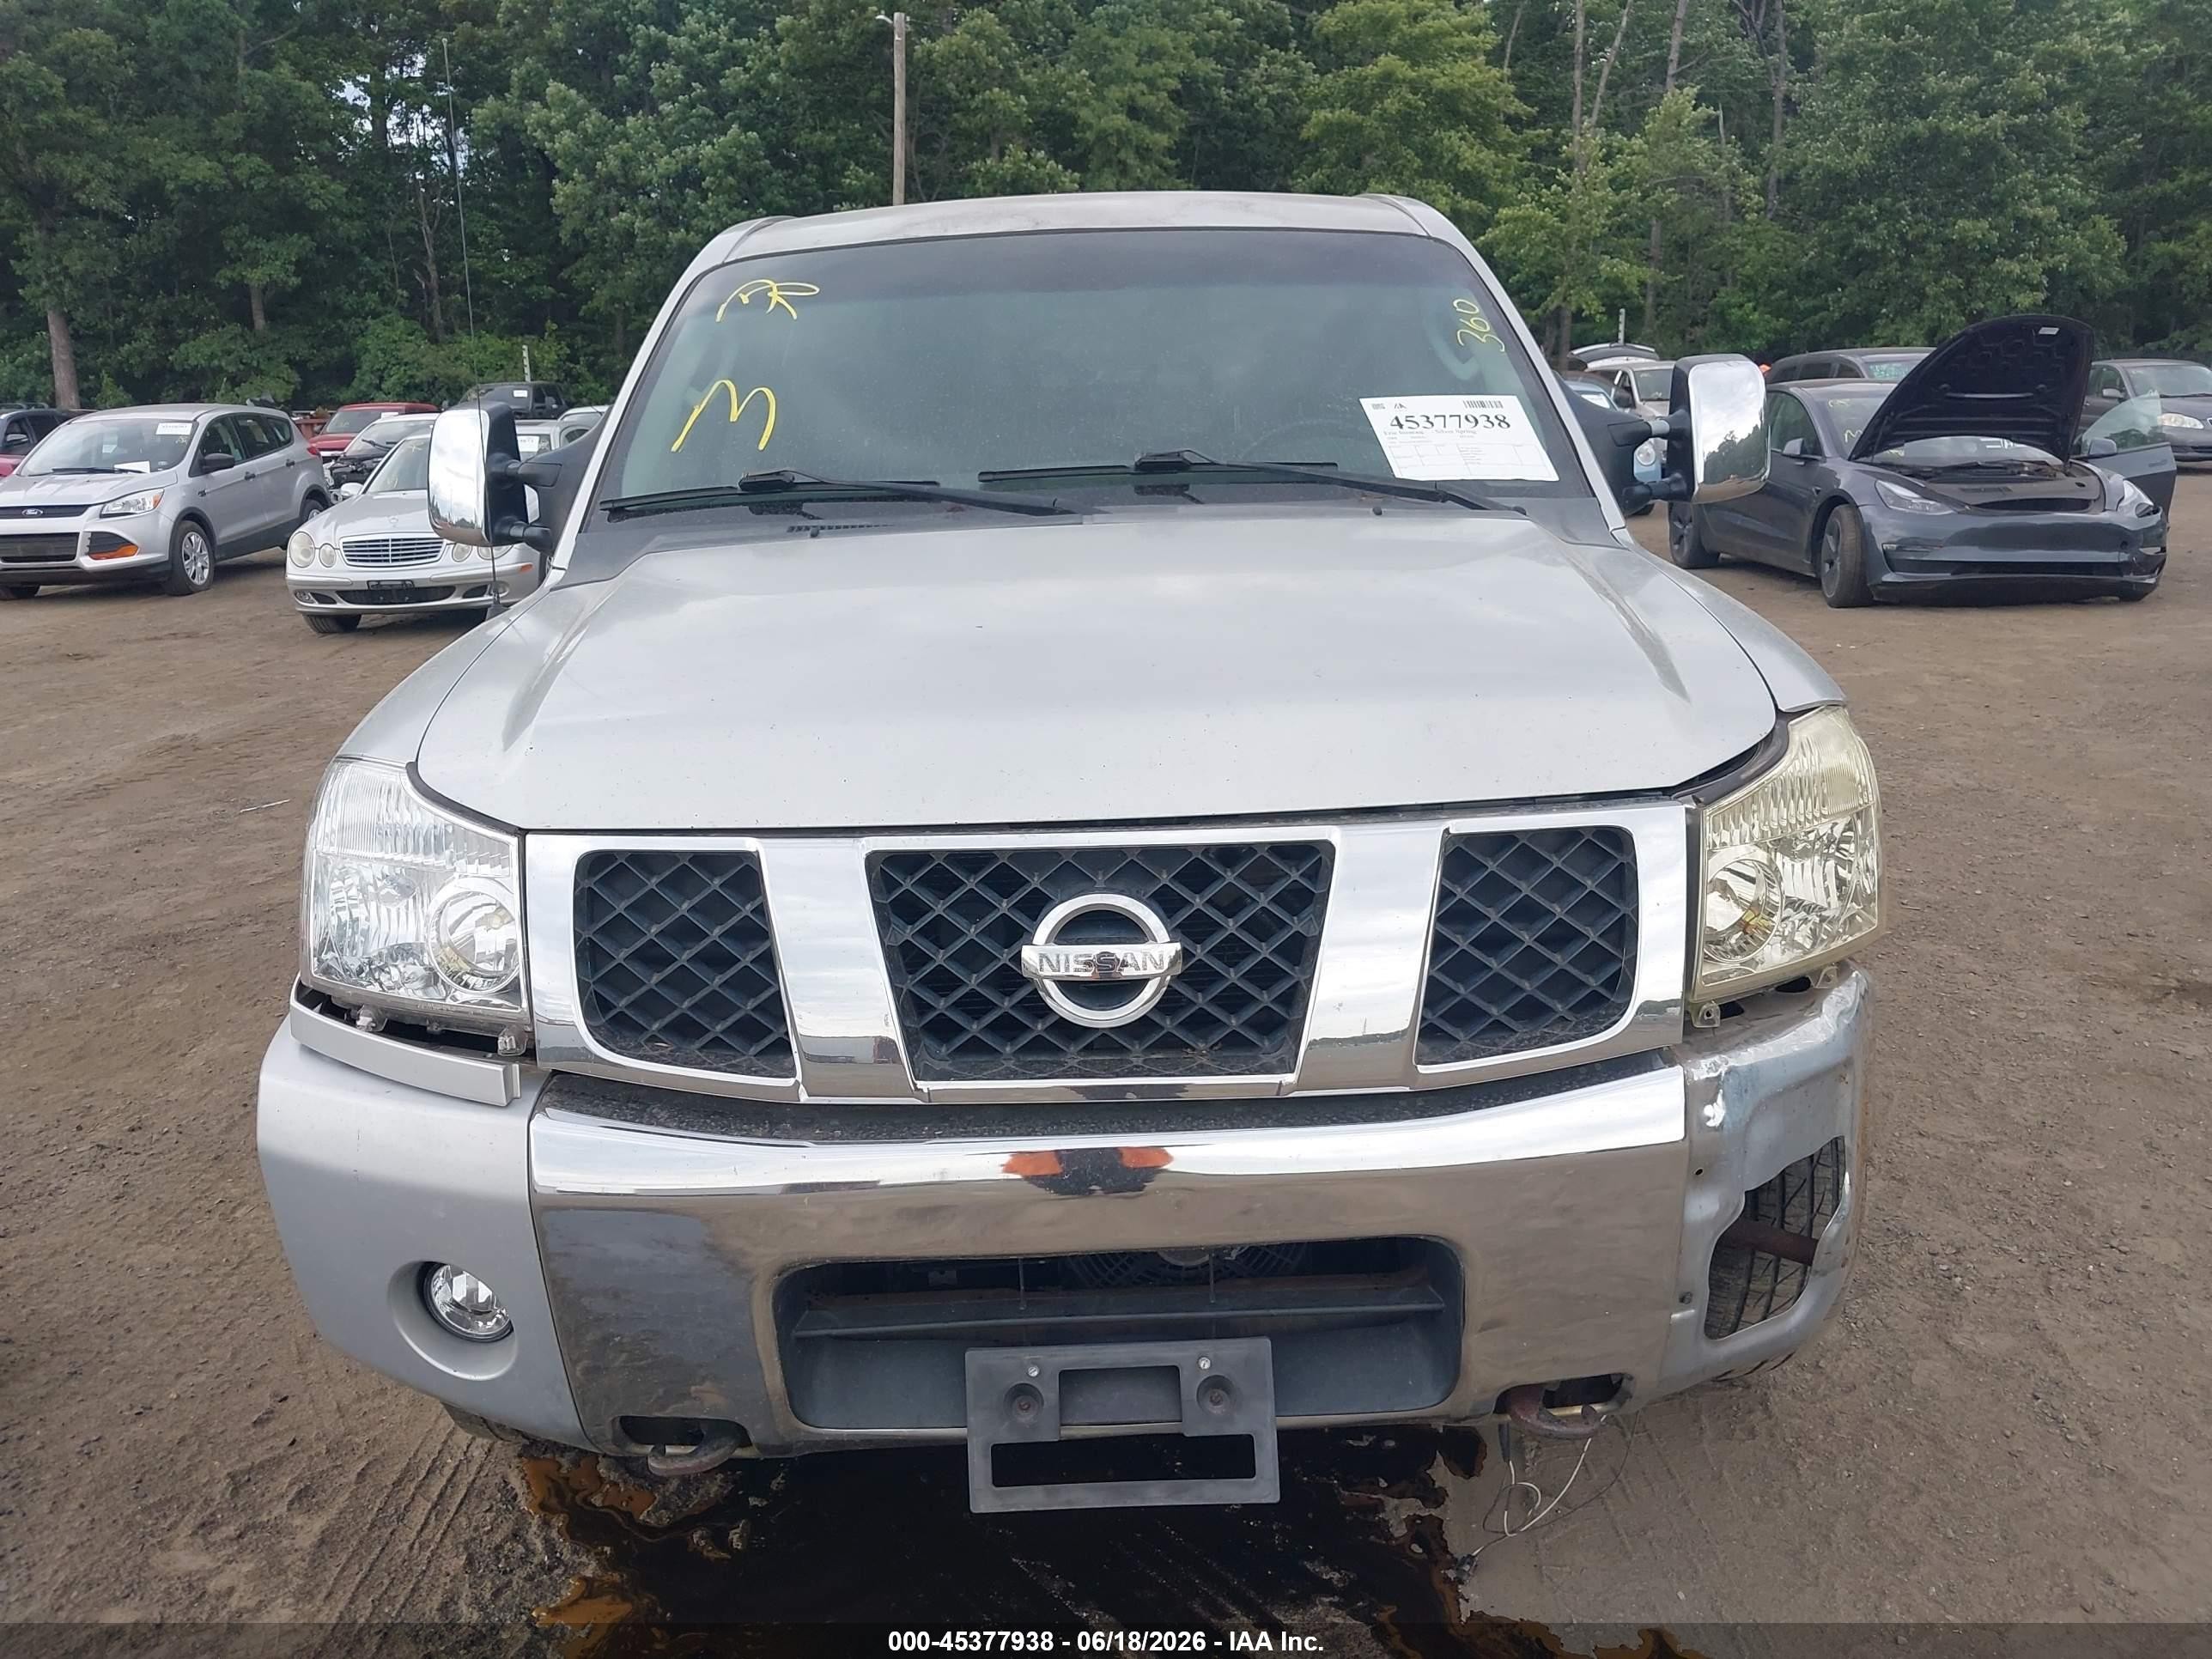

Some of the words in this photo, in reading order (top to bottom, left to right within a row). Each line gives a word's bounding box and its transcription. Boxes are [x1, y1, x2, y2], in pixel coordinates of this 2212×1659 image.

[1453, 299, 1505, 352] 360
[1389, 414, 1511, 430] 45377938
[1037, 951, 1165, 974] NISSAN
